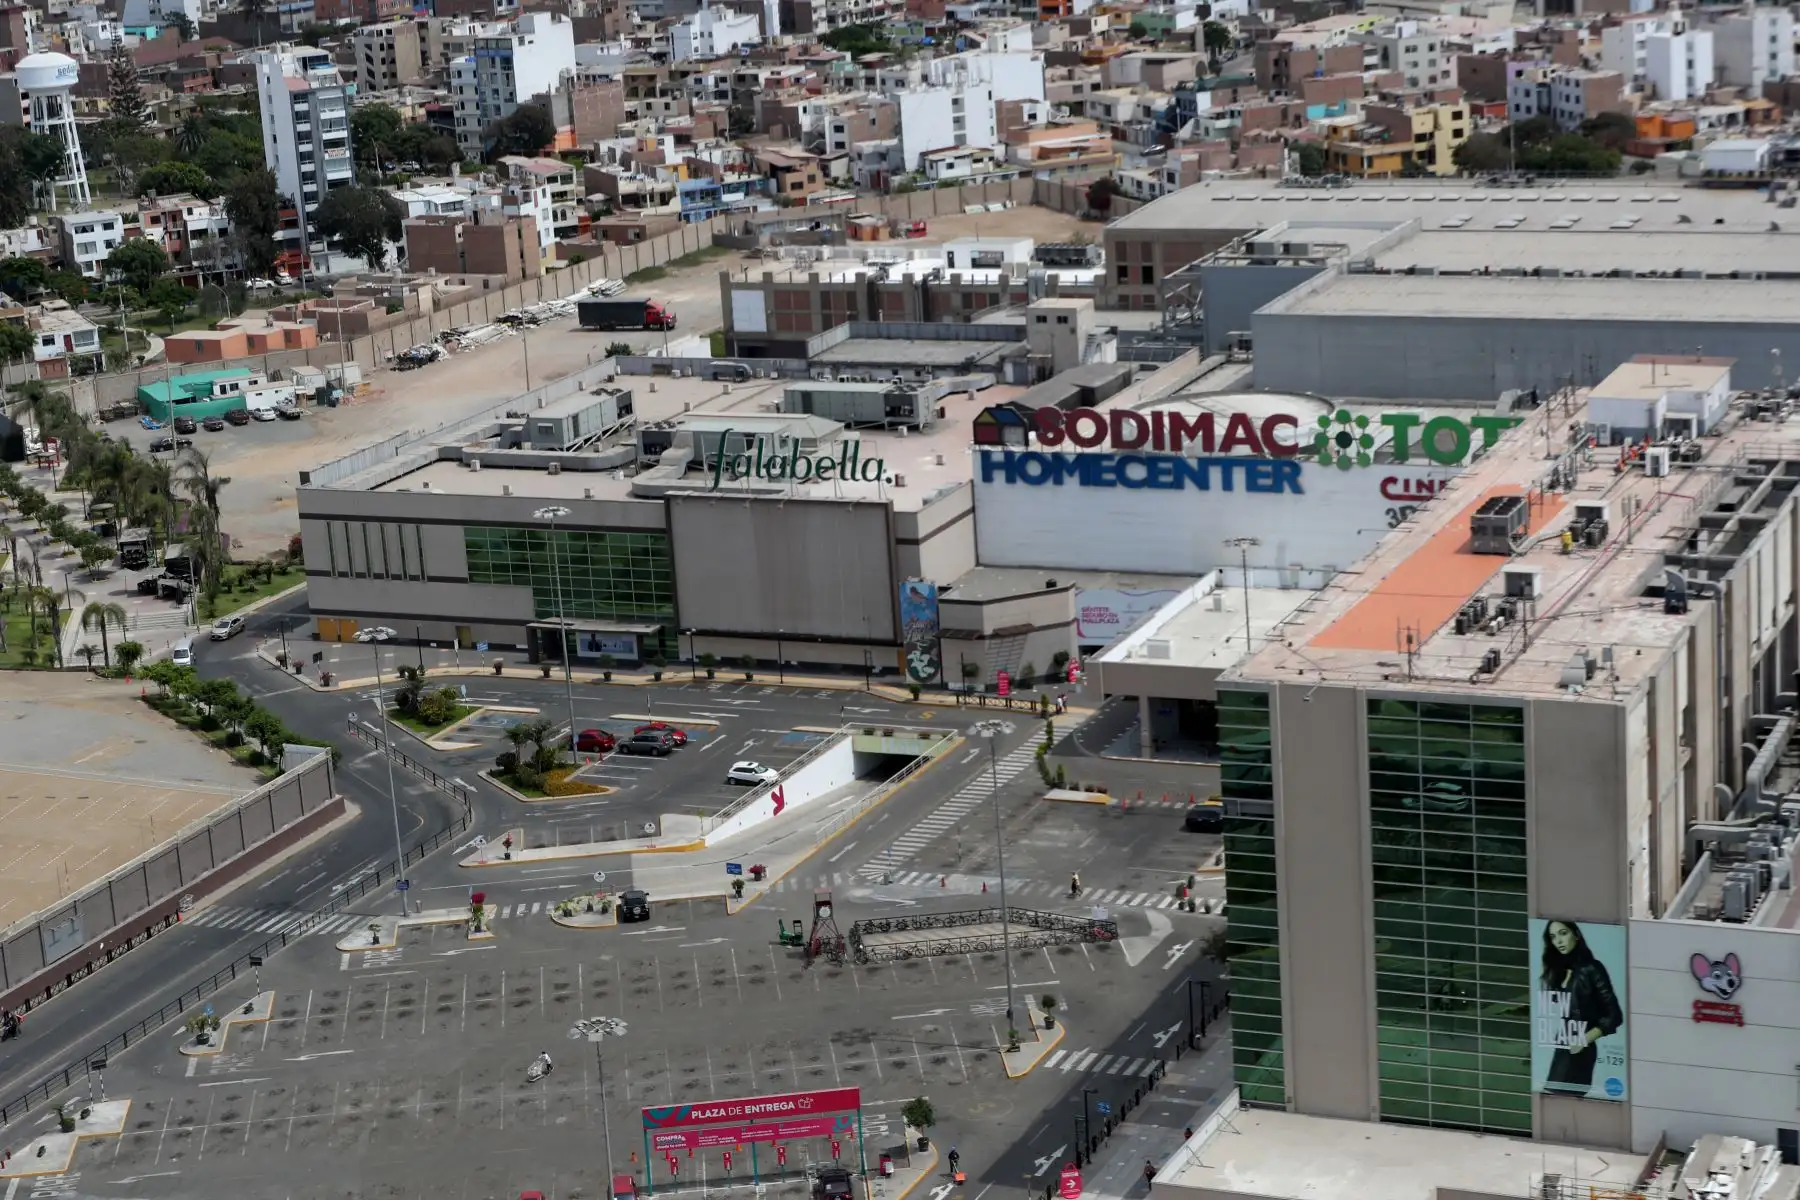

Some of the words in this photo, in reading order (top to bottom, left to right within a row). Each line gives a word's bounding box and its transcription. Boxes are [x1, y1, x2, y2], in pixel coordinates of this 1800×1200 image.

[1034, 407, 1299, 456] SODIMAC
[980, 449, 1305, 494] HOMECENTER
[1539, 990, 1572, 1018] NEW
[1538, 1017, 1589, 1047] BLACK
[1606, 1055, 1624, 1066] 129
[691, 1108, 727, 1120] PLAZA
[728, 1105, 742, 1115] DE
[744, 1101, 796, 1114] ENTREGA
